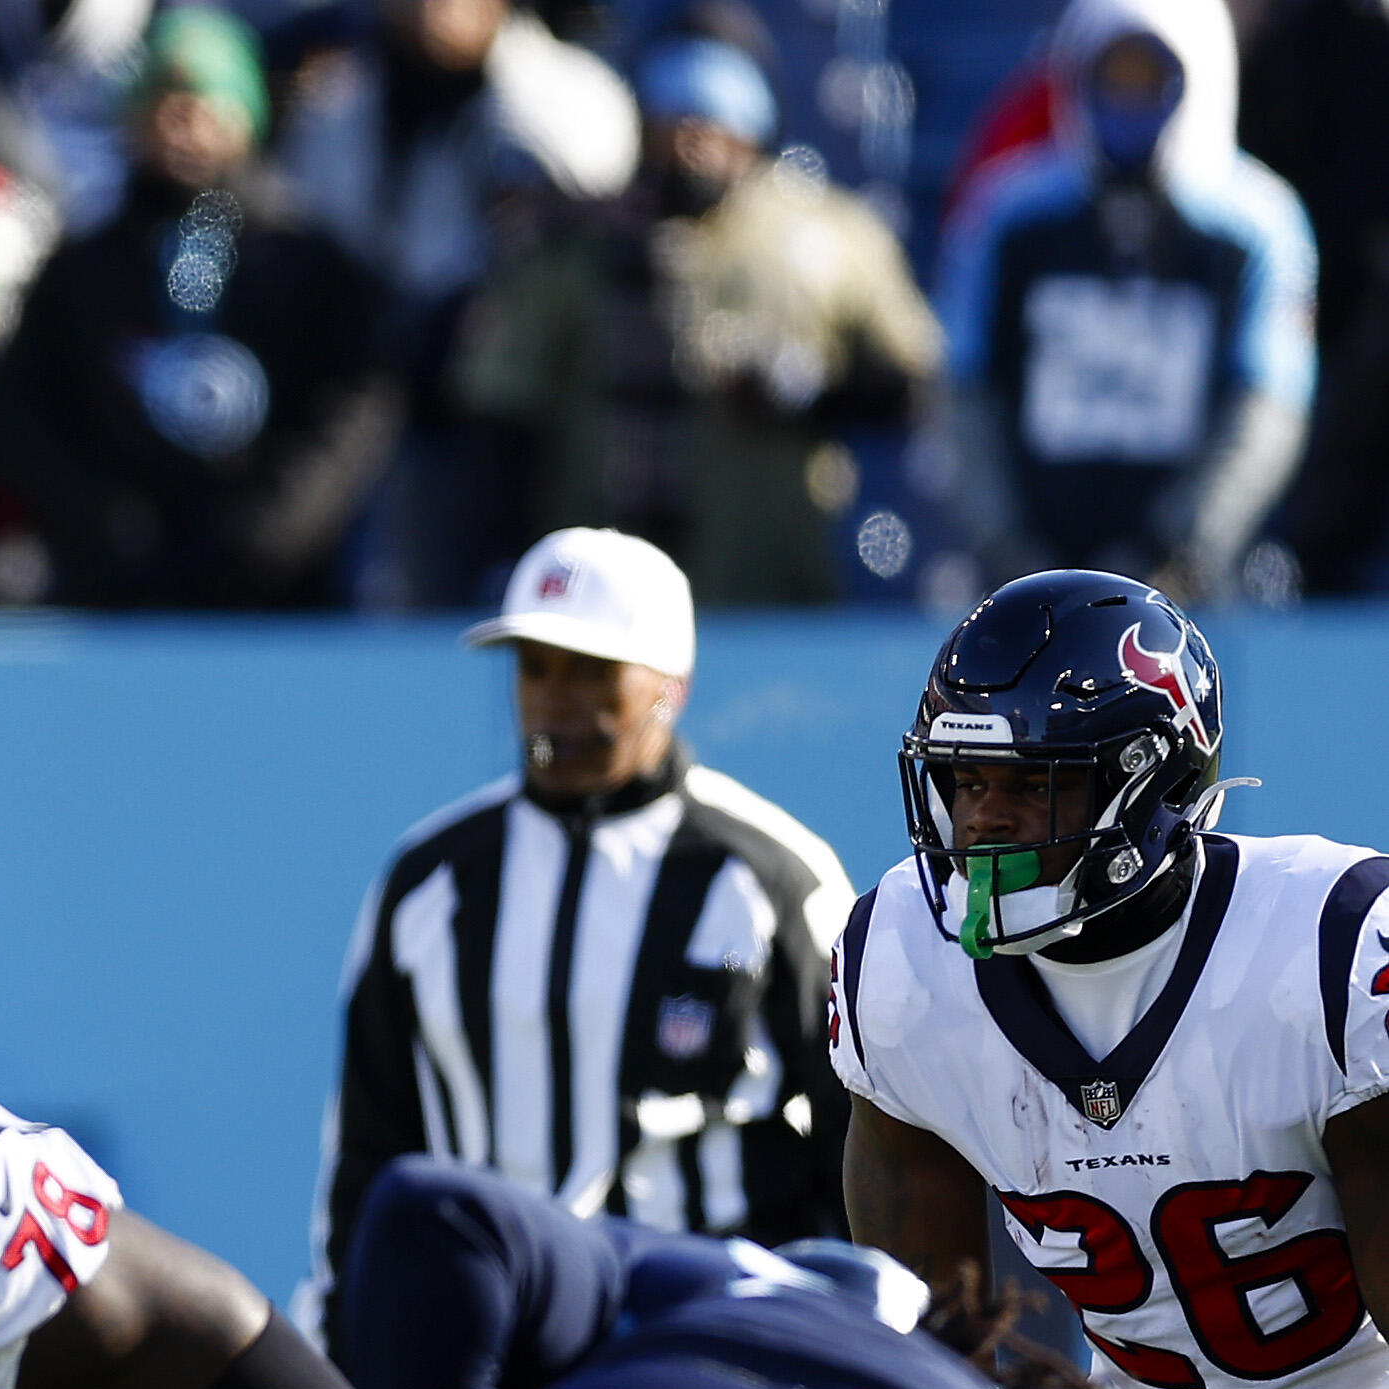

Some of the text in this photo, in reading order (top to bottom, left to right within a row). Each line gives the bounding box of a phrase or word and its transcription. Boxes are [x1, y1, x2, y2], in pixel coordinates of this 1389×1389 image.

[940, 720, 994, 731] TEXANS
[1065, 1154, 1171, 1172] TEXANS
[0, 1159, 110, 1293] 78
